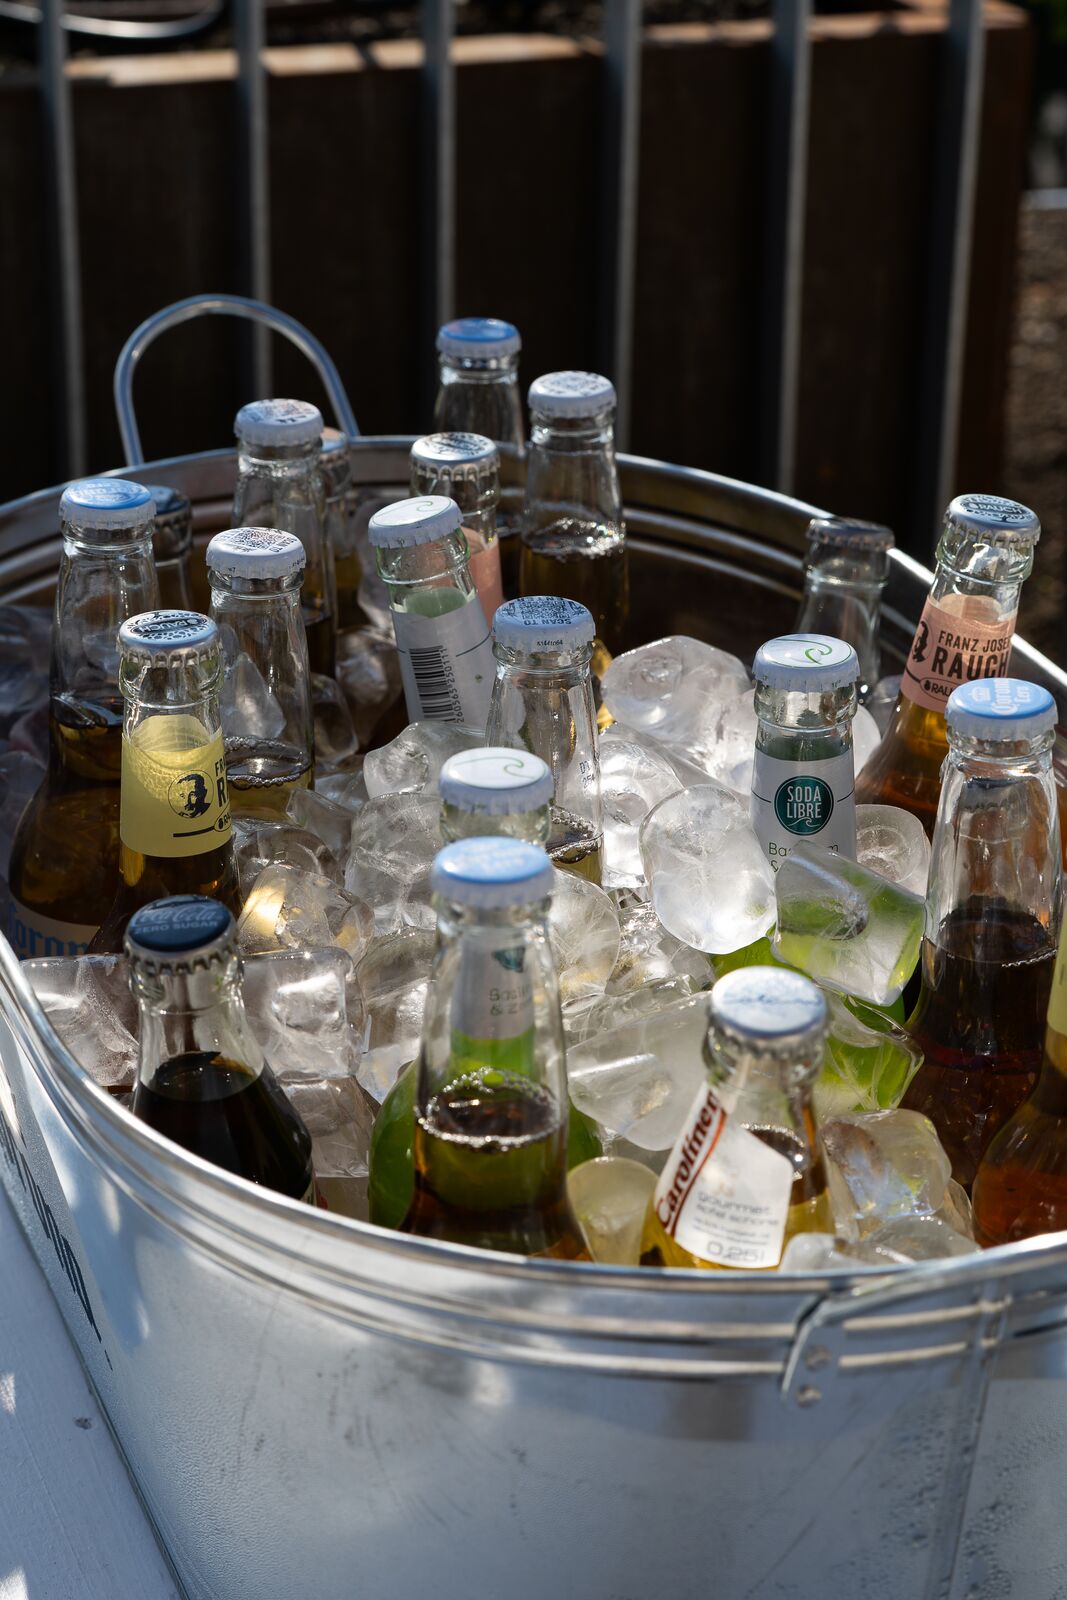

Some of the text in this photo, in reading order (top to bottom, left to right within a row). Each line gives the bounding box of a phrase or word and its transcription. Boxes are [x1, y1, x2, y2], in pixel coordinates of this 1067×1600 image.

[978, 503, 1022, 514] RAUCH
[140, 620, 188, 632] RAUCH
[938, 630, 979, 652] FRANZ
[931, 645, 1010, 681] RAUCH
[931, 682, 953, 697] RAU
[787, 786, 822, 802] SODA
[787, 802, 822, 818] LIBRE
[134, 920, 218, 935] ZERO SUGAR
